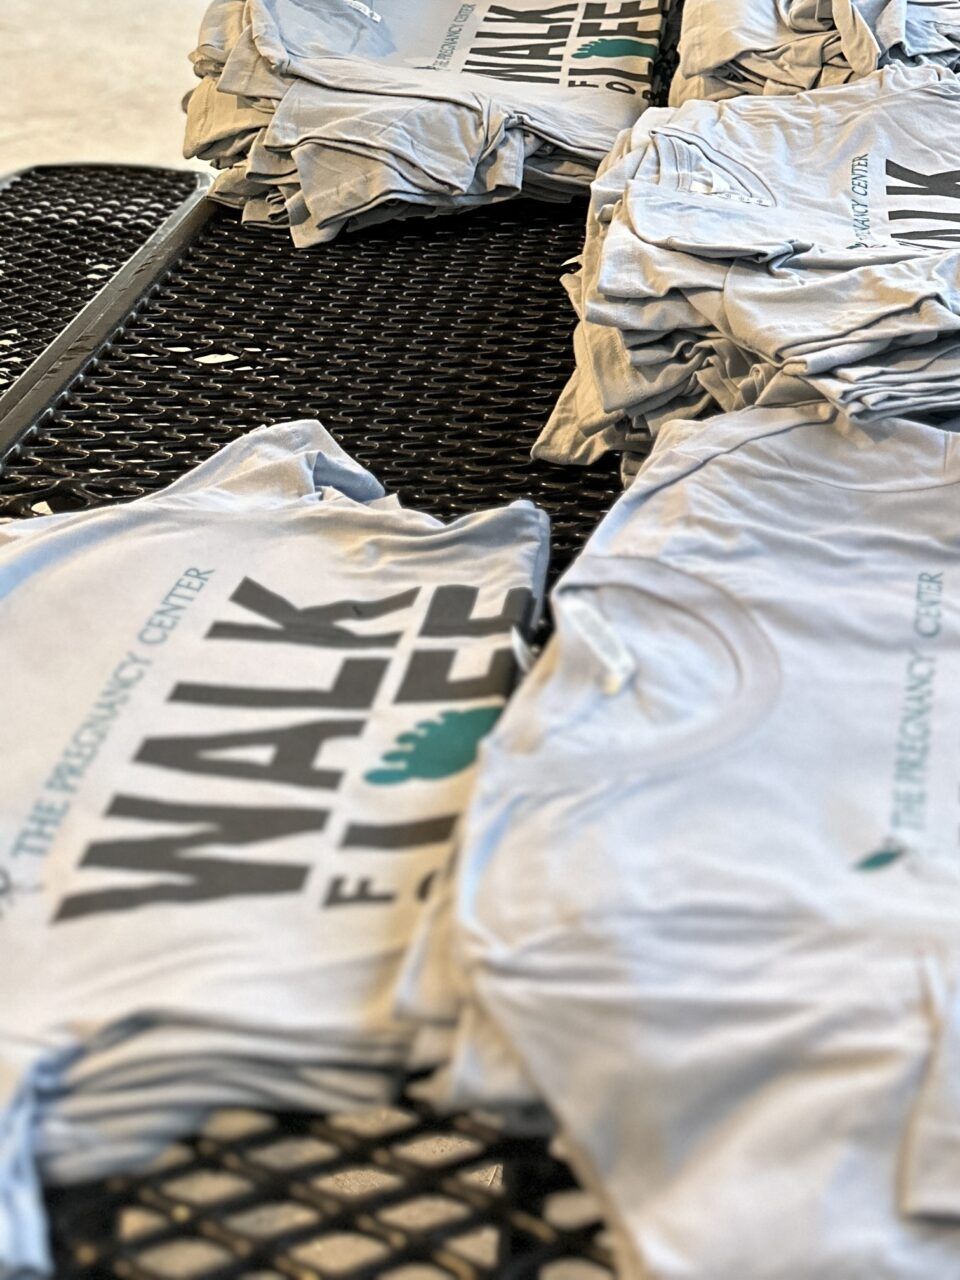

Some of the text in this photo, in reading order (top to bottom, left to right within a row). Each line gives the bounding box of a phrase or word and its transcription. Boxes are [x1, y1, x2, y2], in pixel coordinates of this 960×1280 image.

[461, 3, 579, 84] WALK
[851, 153, 869, 196] CENTER
[913, 572, 944, 639] CENTER
[10, 566, 215, 858] THE PREGNANCY CENTER
[49, 575, 422, 926] WALK
